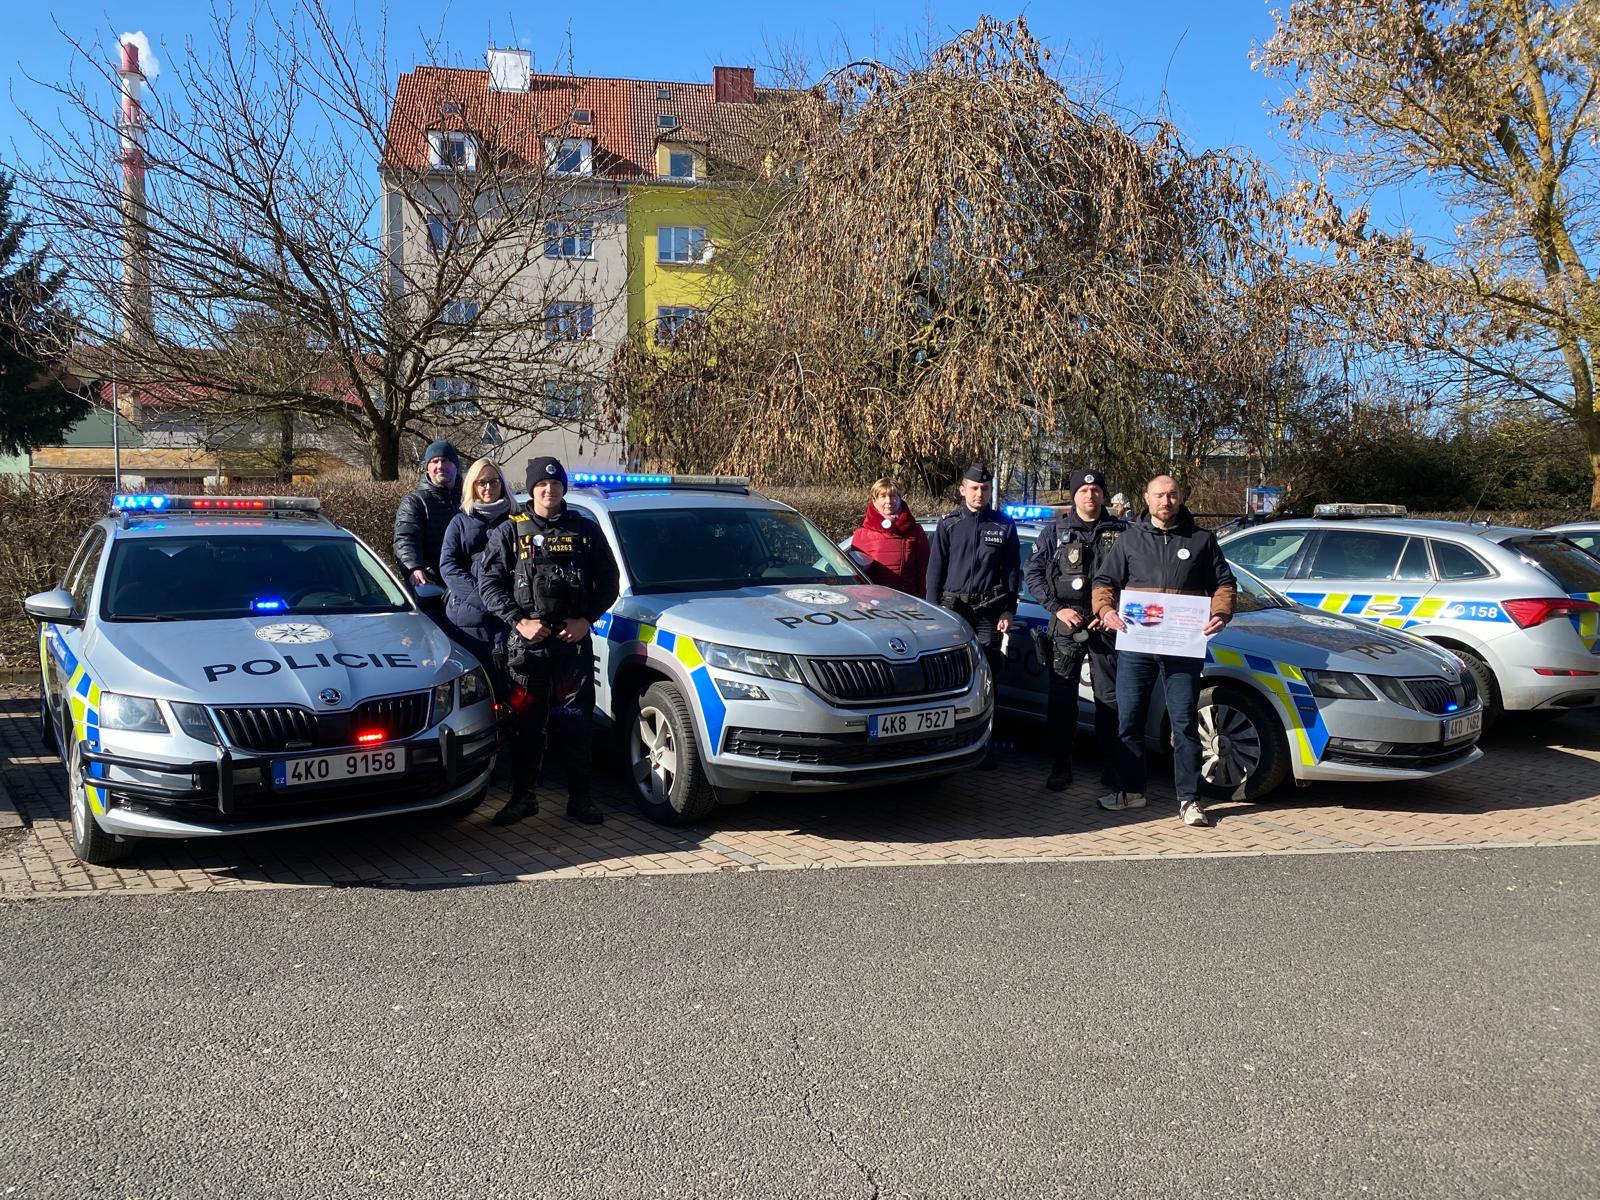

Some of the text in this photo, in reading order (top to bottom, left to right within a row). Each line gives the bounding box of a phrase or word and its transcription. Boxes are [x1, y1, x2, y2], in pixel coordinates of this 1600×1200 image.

[775, 608, 936, 630] POLICIE
[1470, 605, 1498, 618] 158
[202, 653, 418, 683] POLICIE
[881, 709, 949, 735] 4K8 7527
[291, 751, 396, 781] 4K0 9158
[274, 776, 285, 785] CZ
